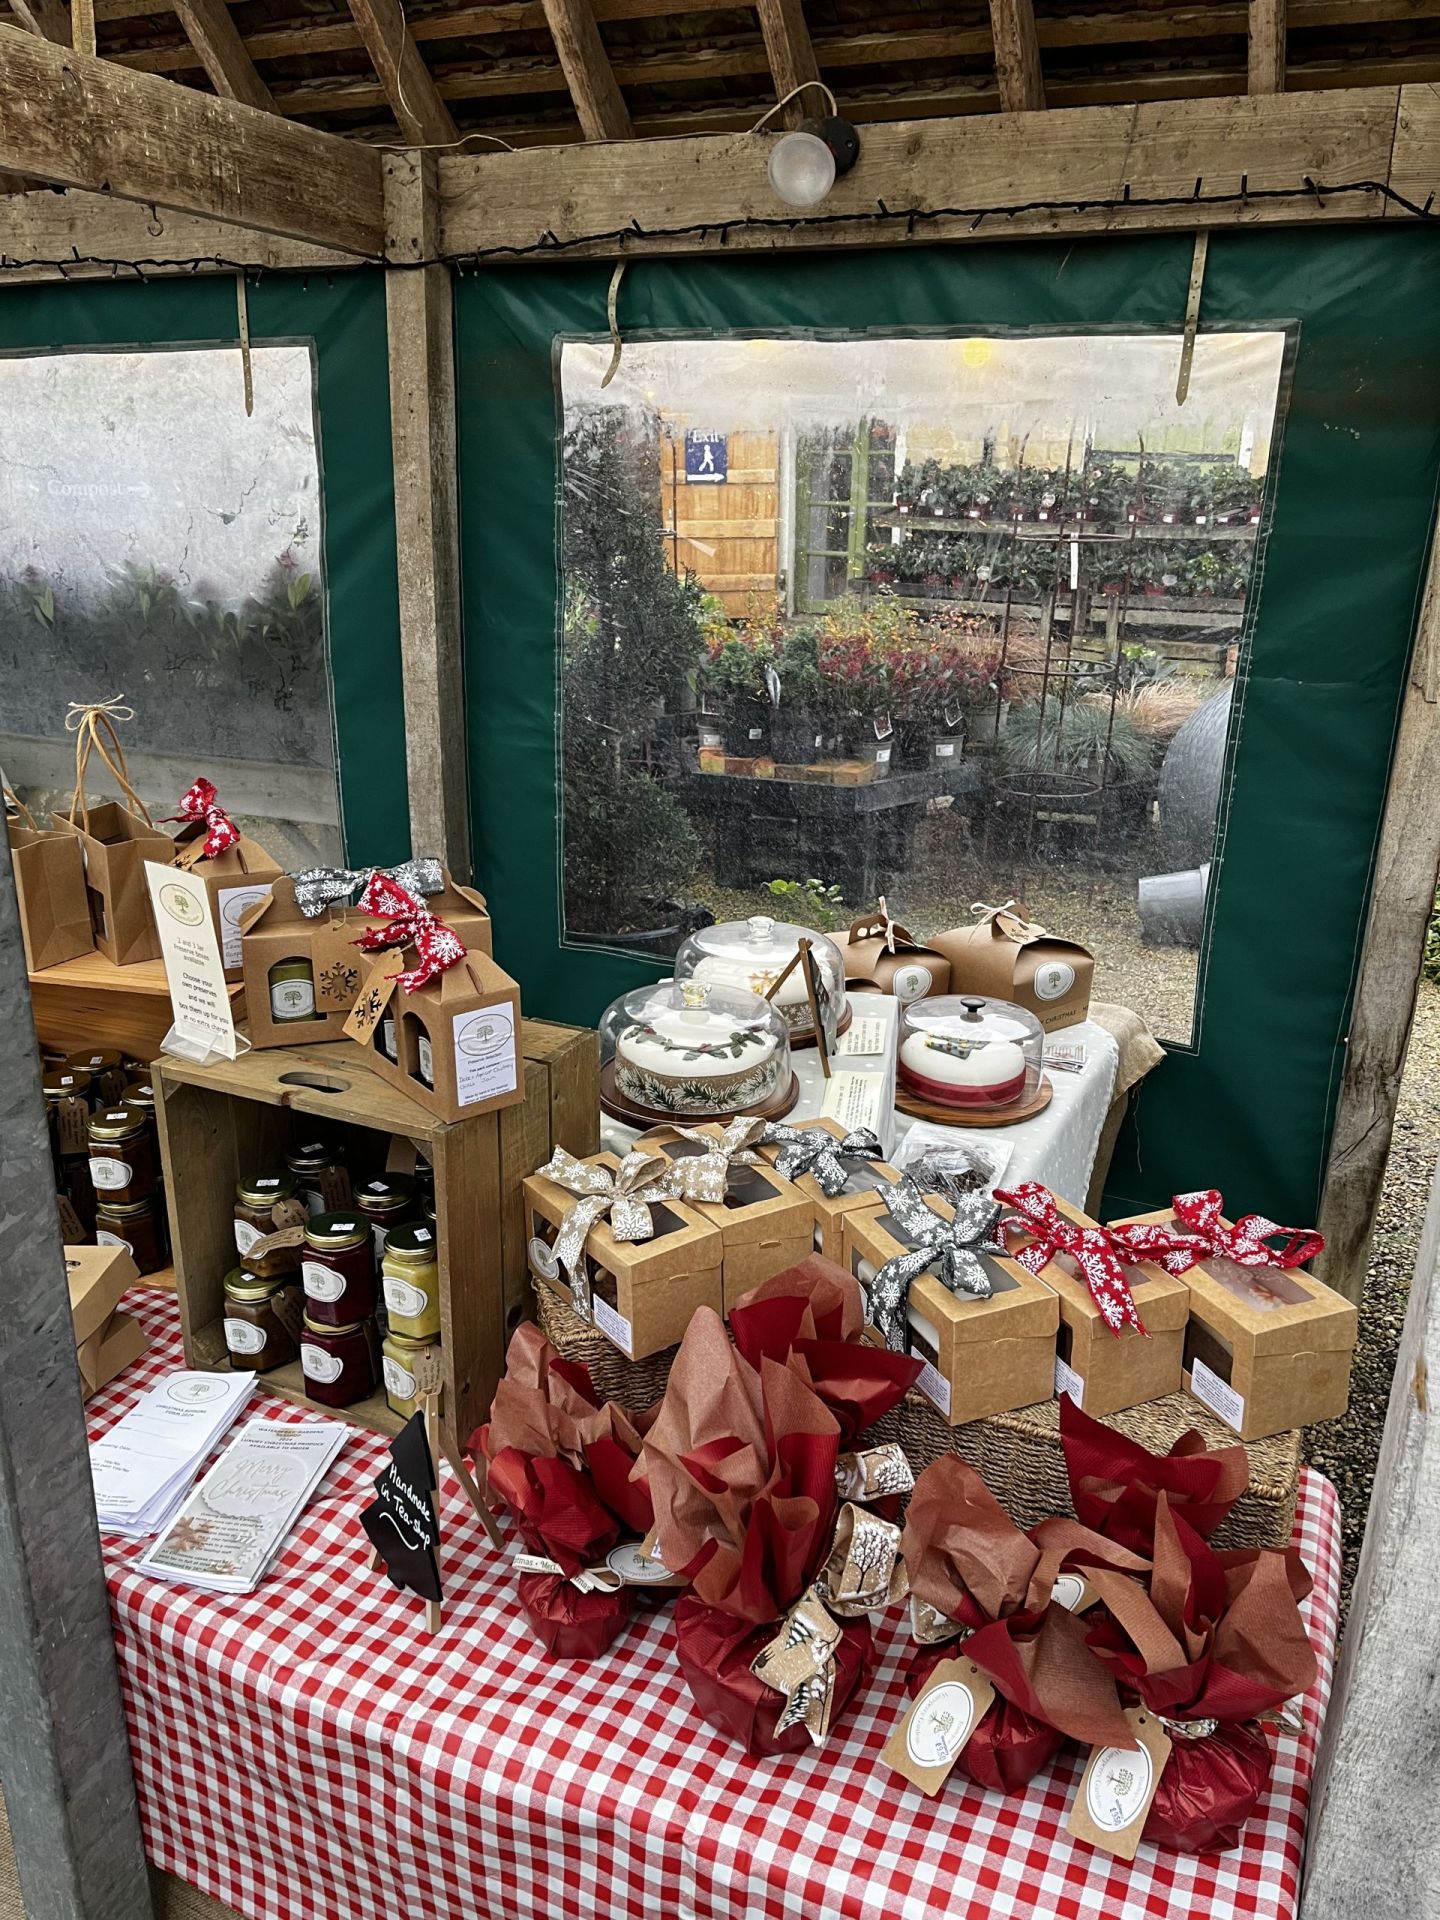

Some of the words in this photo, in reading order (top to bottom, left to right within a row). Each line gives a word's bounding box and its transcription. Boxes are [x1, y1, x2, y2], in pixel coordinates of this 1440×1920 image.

[692, 429, 719, 443] Exit
[47, 479, 124, 498] Compost
[182, 972, 201, 983] Choose
[193, 985, 217, 998] preserves
[232, 1459, 294, 1485] Merry
[208, 1479, 292, 1504] Christmas
[389, 1463, 431, 1522] Handmade
[381, 1483, 391, 1502] in
[393, 1494, 431, 1551] Tea-Shop
